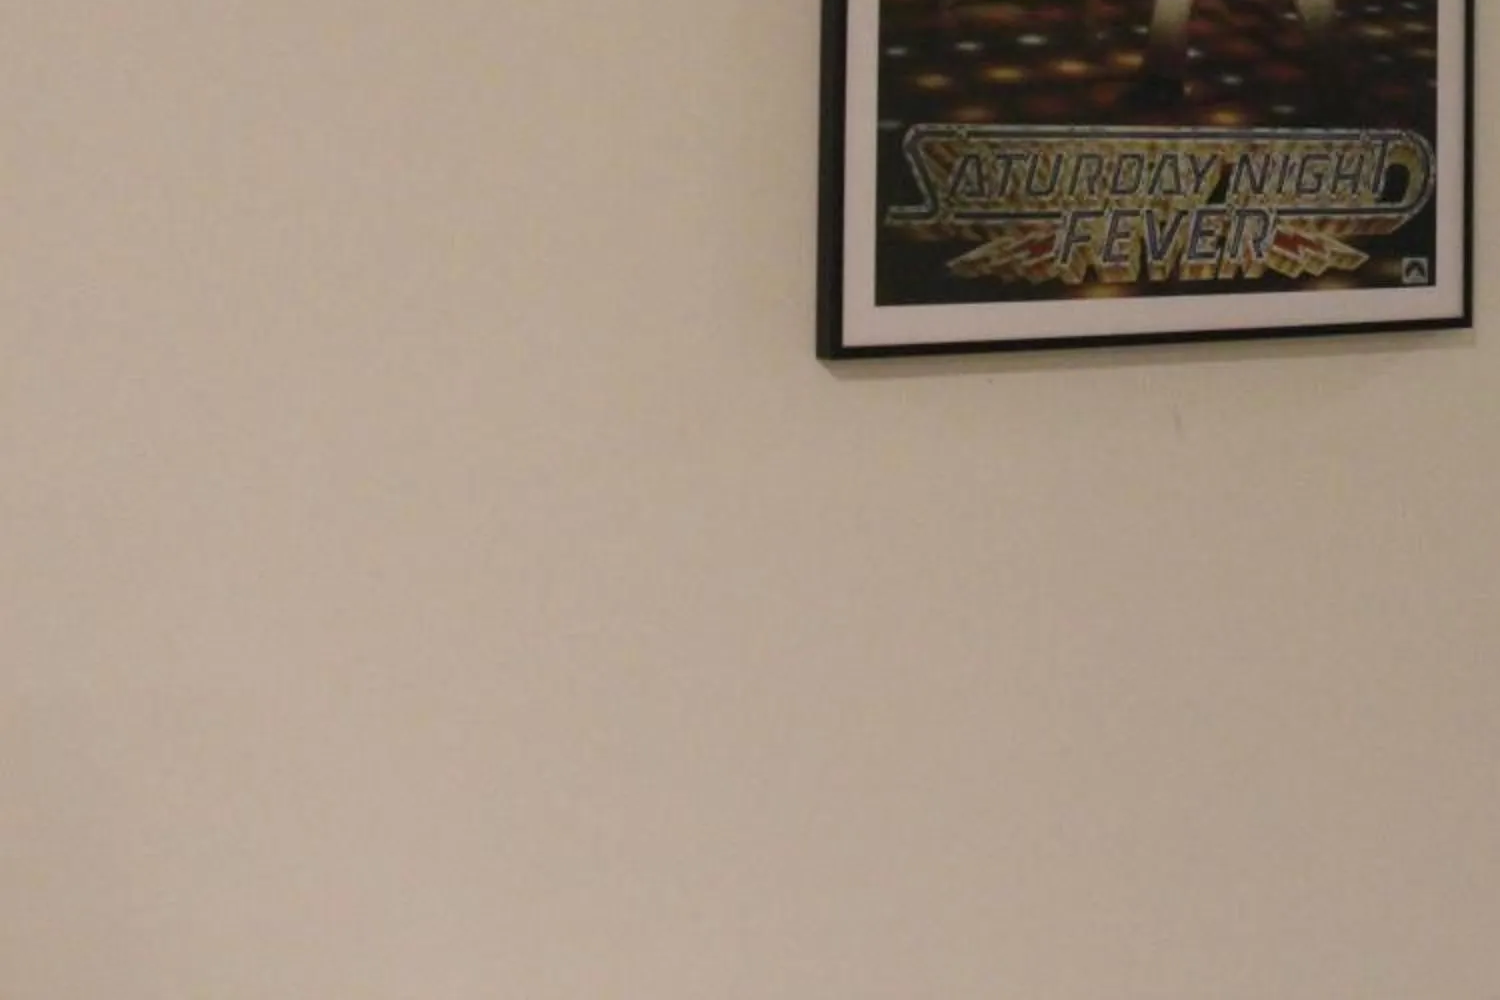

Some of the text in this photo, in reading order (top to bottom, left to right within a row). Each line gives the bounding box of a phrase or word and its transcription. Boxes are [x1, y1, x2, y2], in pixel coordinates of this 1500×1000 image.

[884, 123, 1437, 226] SATURDAY NIGHT
[1049, 206, 1275, 279] FEVER
